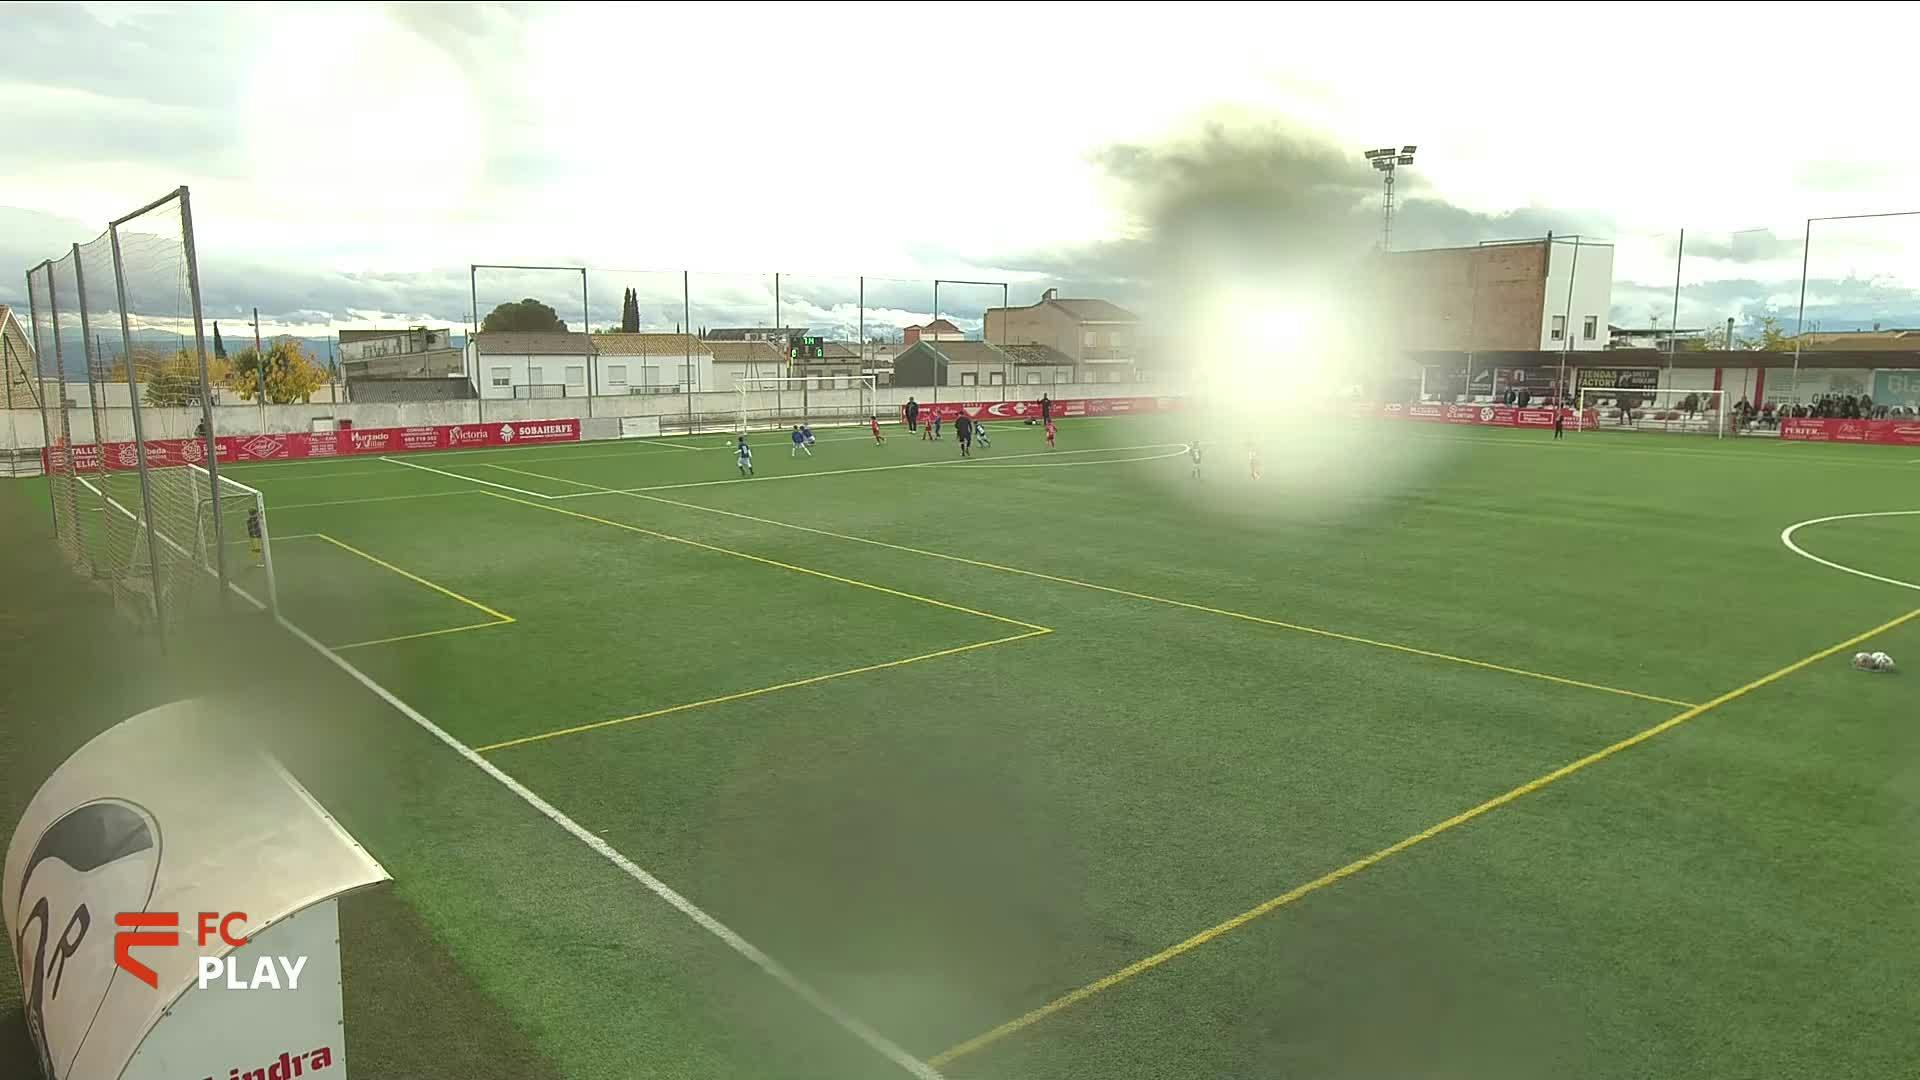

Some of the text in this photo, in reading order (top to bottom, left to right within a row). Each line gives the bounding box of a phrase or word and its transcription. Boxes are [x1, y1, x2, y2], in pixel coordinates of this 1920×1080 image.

[1580, 370, 1617, 379] TIENDAS
[1578, 378, 1617, 387] FACTORY
[519, 424, 573, 435] SOBAHERFE
